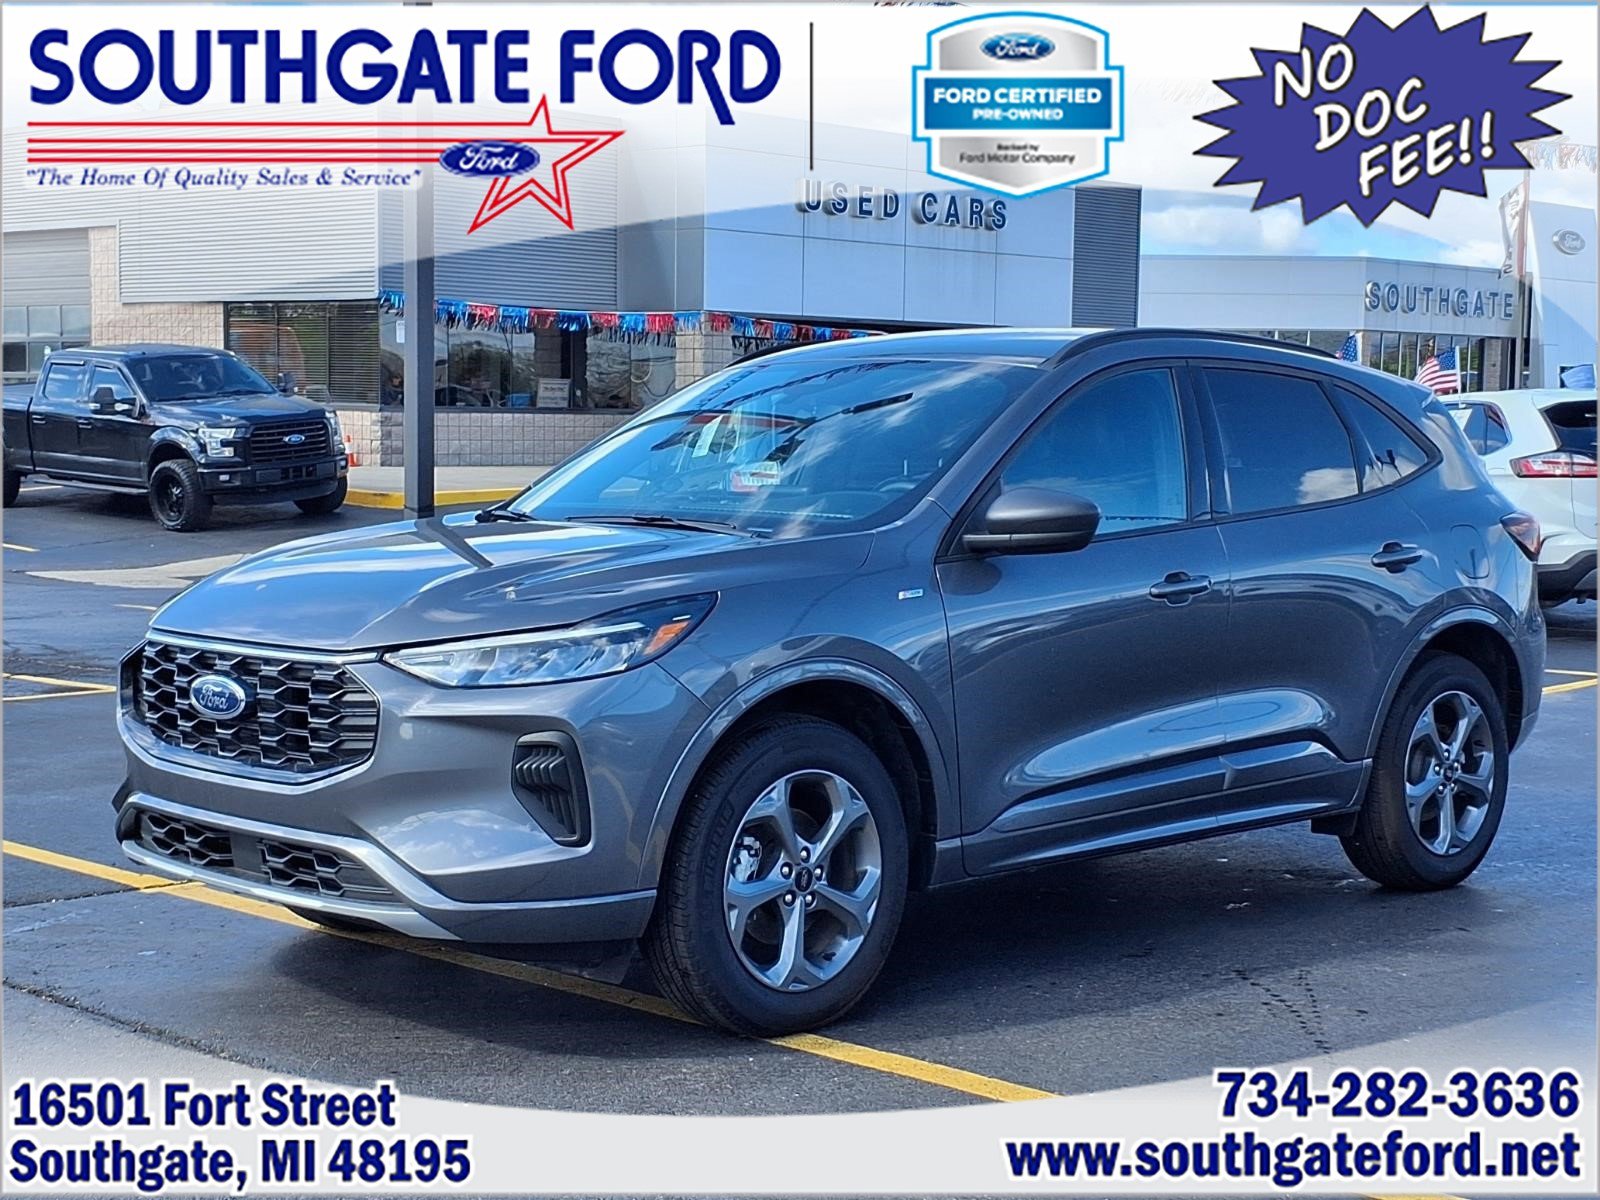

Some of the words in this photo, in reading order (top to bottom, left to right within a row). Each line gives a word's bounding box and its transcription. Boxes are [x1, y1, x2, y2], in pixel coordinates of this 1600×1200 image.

[801, 178, 900, 219] USED
[917, 191, 1008, 231] CARS
[1366, 281, 1514, 319] SOUTHGATE
[200, 684, 230, 710] Ford
